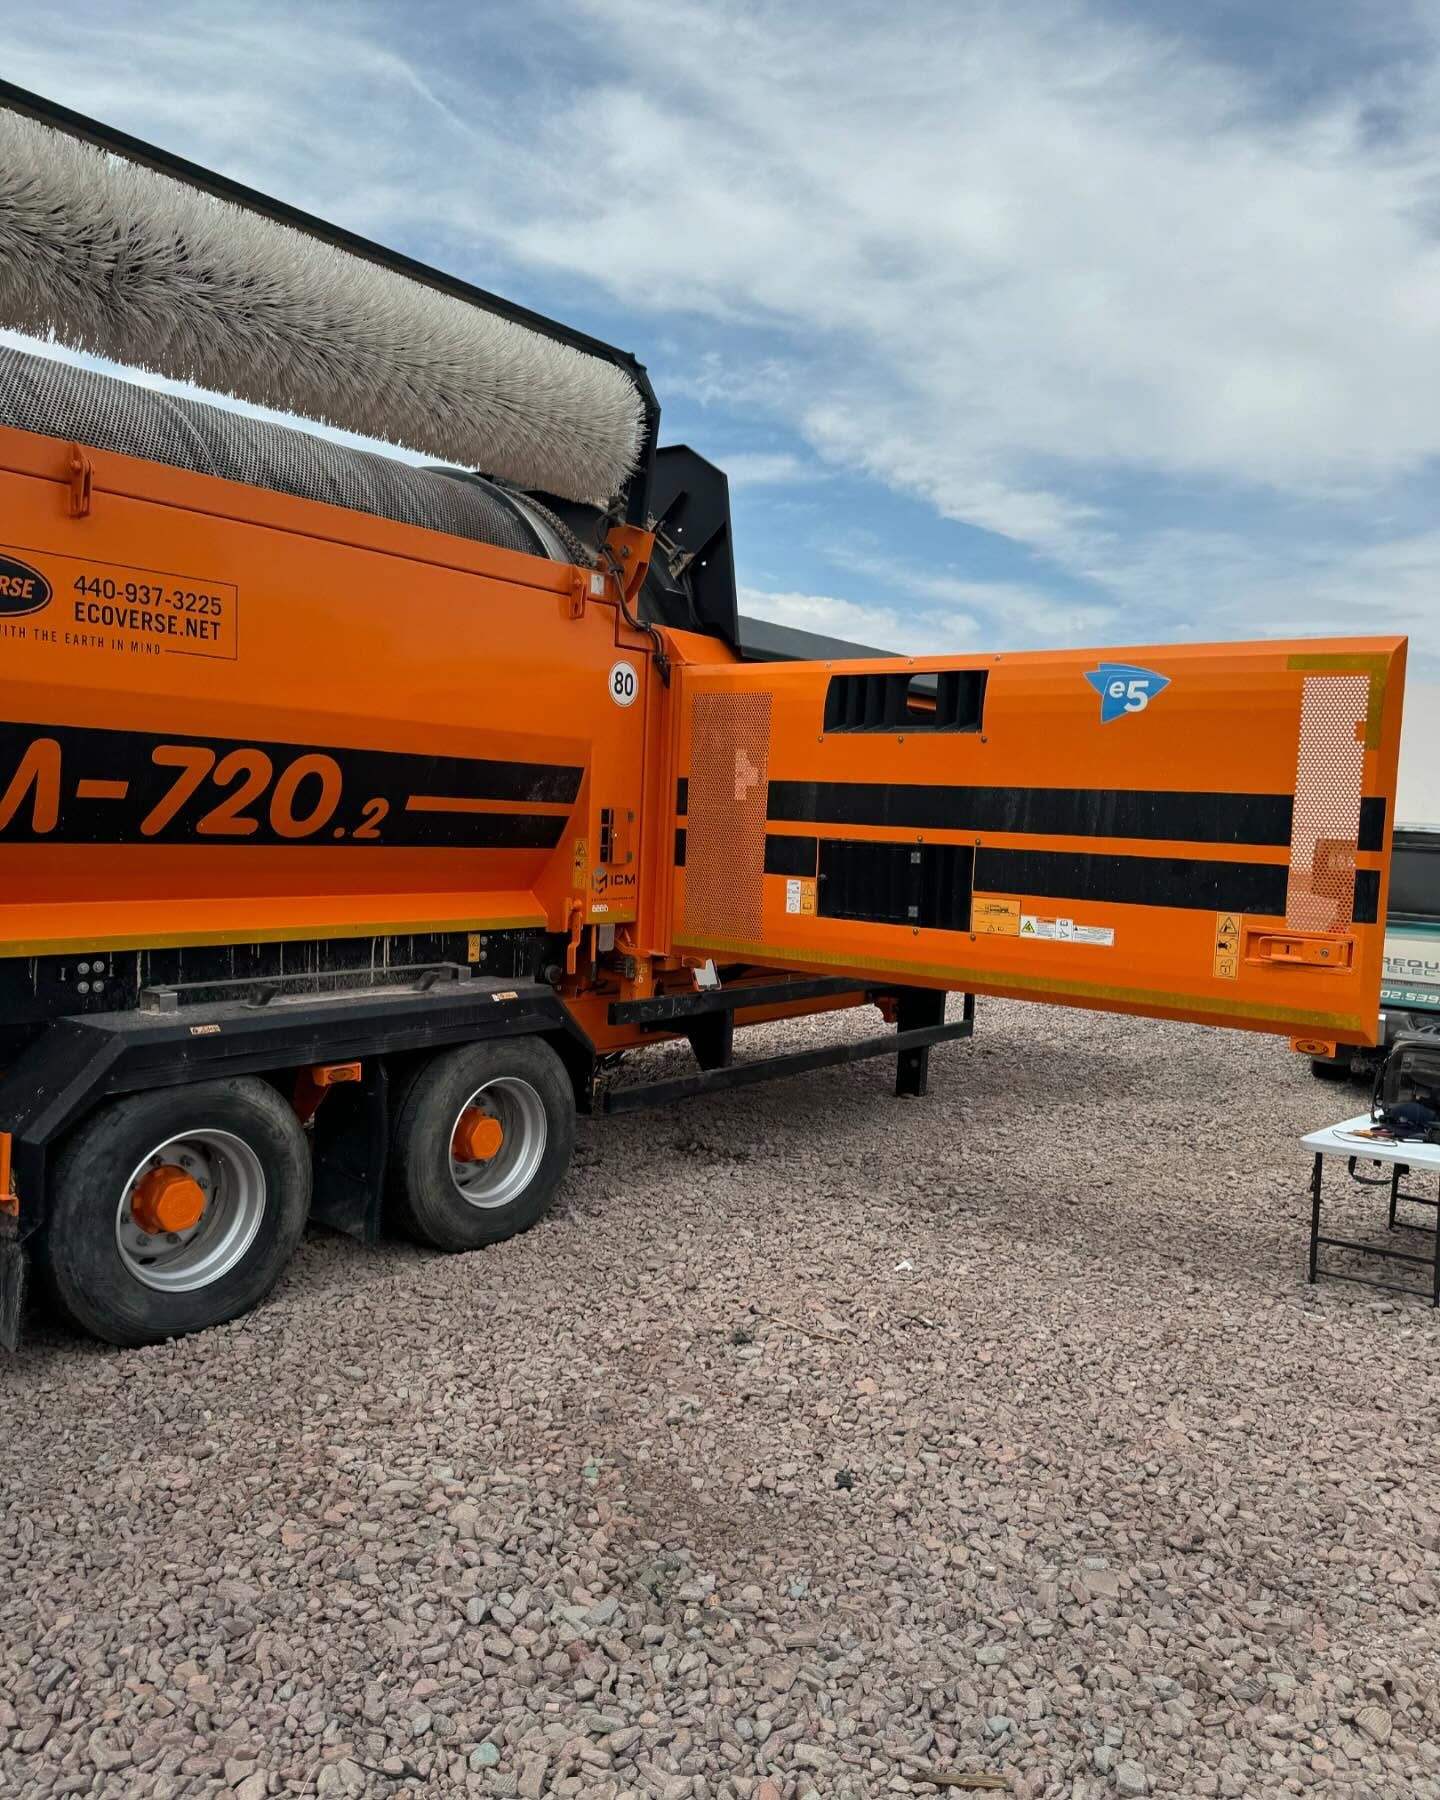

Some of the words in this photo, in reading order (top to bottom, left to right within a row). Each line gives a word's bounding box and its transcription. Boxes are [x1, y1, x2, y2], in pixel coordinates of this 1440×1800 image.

[74, 575, 222, 616] 440-937-3225
[75, 601, 221, 640] ECOVERSE.NET
[0, 624, 26, 639] ITH
[34, 628, 57, 642] THE
[65, 633, 104, 648] EARTH
[112, 639, 124, 651] IN
[131, 642, 160, 655] MIND
[614, 671, 634, 697] 80
[1109, 681, 1149, 712] e5
[610, 874, 636, 886] ICM
